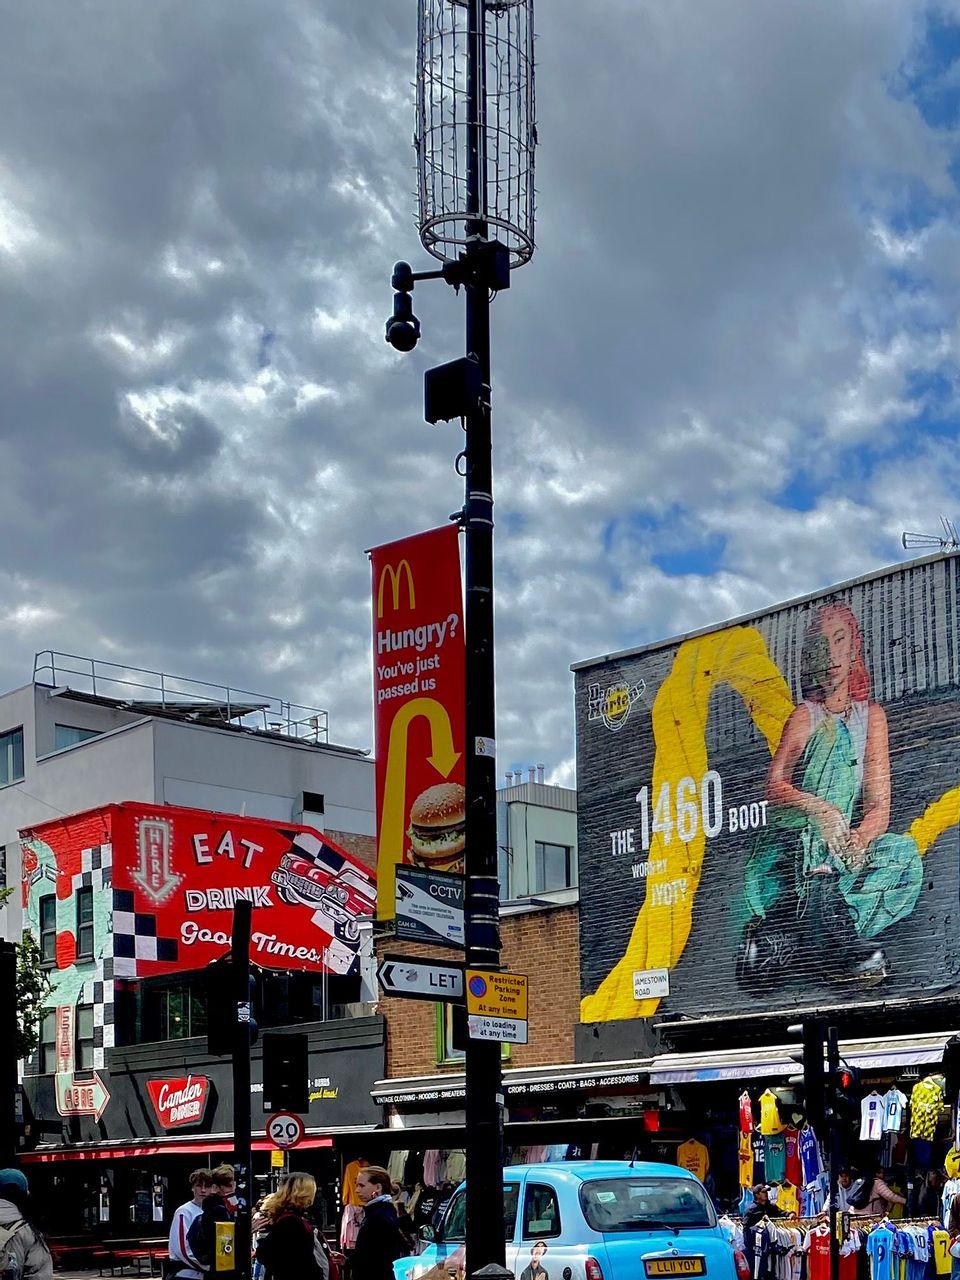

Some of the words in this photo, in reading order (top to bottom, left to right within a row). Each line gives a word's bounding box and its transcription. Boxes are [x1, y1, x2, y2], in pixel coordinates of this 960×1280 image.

[377, 614, 459, 654] Hungry?
[377, 661, 414, 681] You've
[415, 654, 440, 677] just
[377, 677, 419, 704] passed
[421, 678, 436, 690] us
[610, 828, 635, 856] THE
[635, 770, 723, 850] 1460
[728, 800, 769, 833] BOOT
[193, 830, 264, 868] EAT
[150, 829, 161, 888] HERE
[185, 885, 274, 911] DRINK
[429, 884, 461, 900] CCTV
[252, 932, 321, 963] Times
[429, 973, 457, 988] LET
[489, 975, 525, 986] Restricted
[635, 975, 667, 986] JAMESTOWN
[494, 985, 520, 995] Parking
[499, 994, 516, 1002] Zone
[635, 988, 650, 996] ROAD
[488, 1005, 500, 1014] any
[502, 1006, 517, 1015] time
[492, 1020, 516, 1031] loading
[488, 1030, 500, 1039] any
[502, 1030, 517, 1038] time
[508, 1085, 526, 1094] CROPS
[530, 1083, 554, 1092] DRESSES
[558, 1081, 576, 1090] COATS
[580, 1079, 596, 1088] BAGS
[599, 1074, 639, 1085] ACCESSORIES
[158, 1075, 202, 1112] Camden
[376, 1095, 394, 1103] VINTAGE
[394, 1094, 415, 1102] CLOTHING
[418, 1091, 438, 1100] HOODIES
[441, 1089, 466, 1098] SWEATERS
[170, 1101, 200, 1122] DINER
[272, 1123, 298, 1138] 20
[877, 1244, 886, 1263] 9
[940, 1240, 947, 1258] 7
[677, 1260, 696, 1271] YOY
